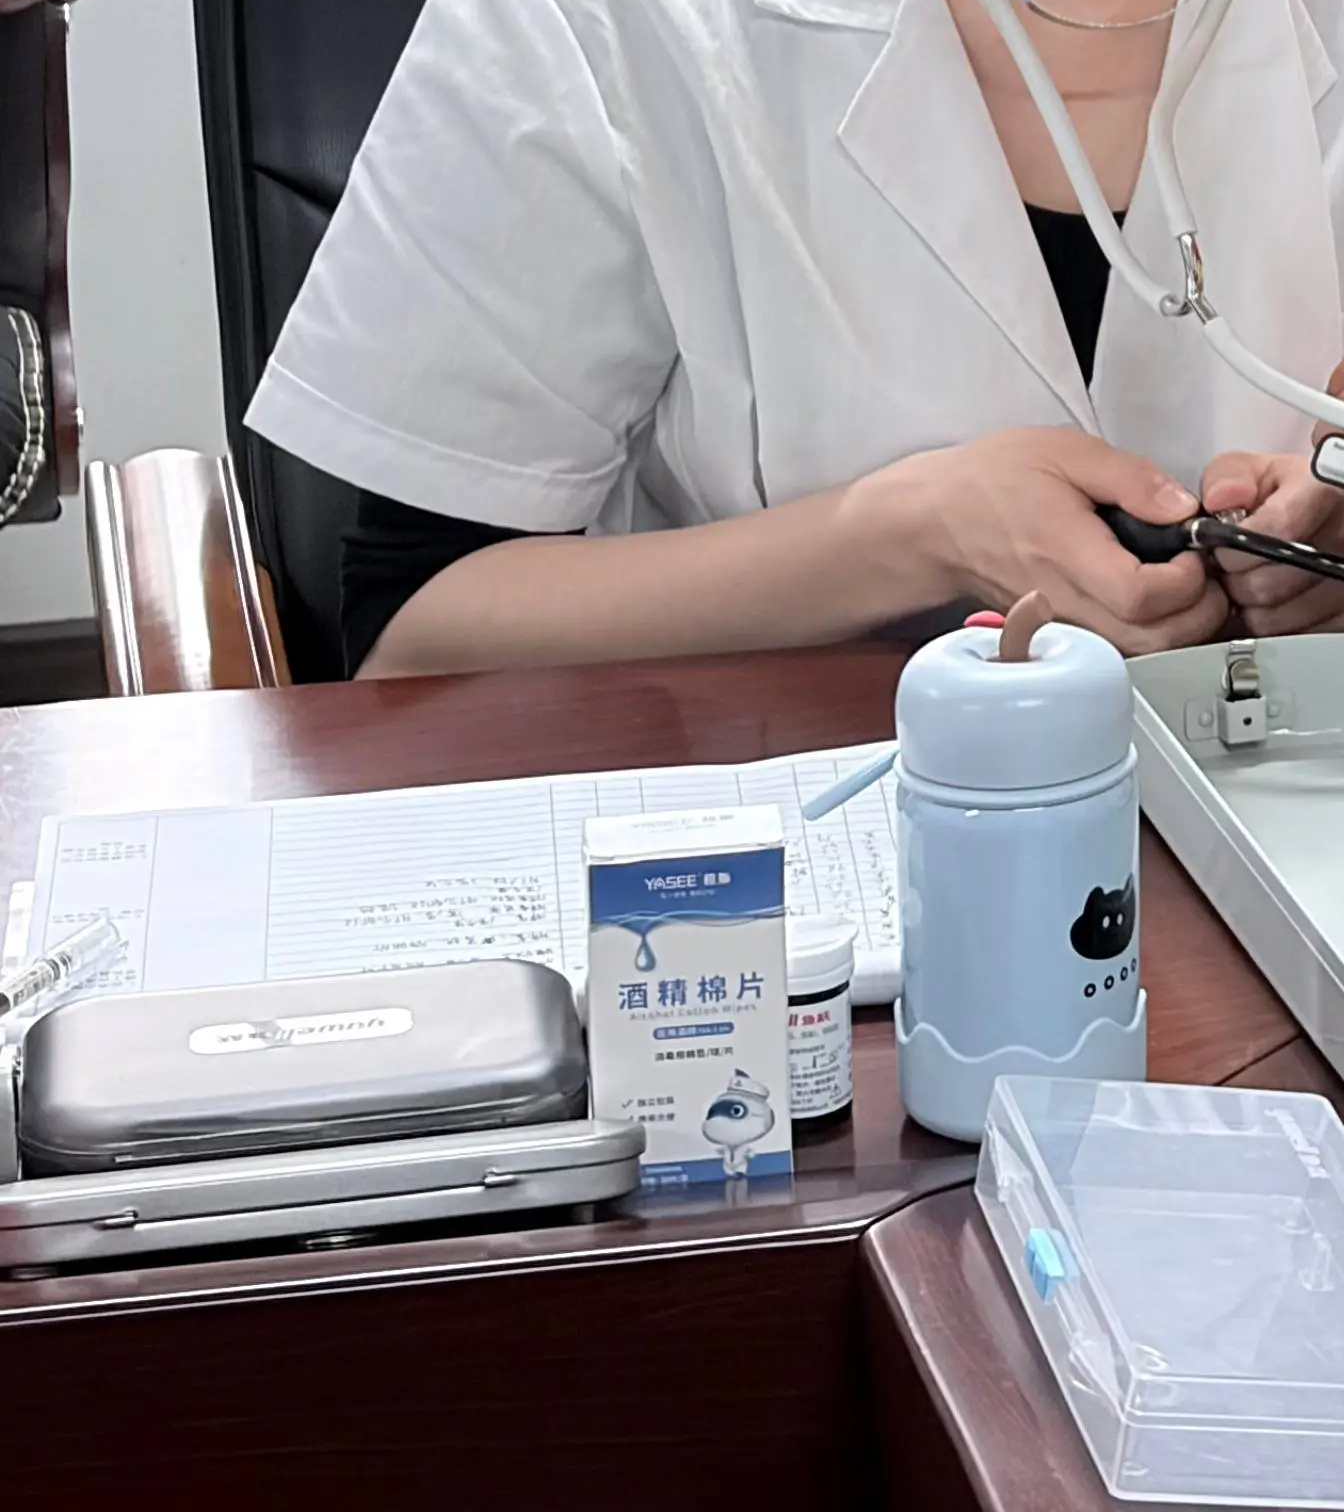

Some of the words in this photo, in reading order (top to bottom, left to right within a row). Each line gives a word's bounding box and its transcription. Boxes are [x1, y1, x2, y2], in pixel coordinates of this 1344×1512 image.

[644, 873, 698, 891] YASEE
[618, 971, 765, 1011] 酒精棉片
